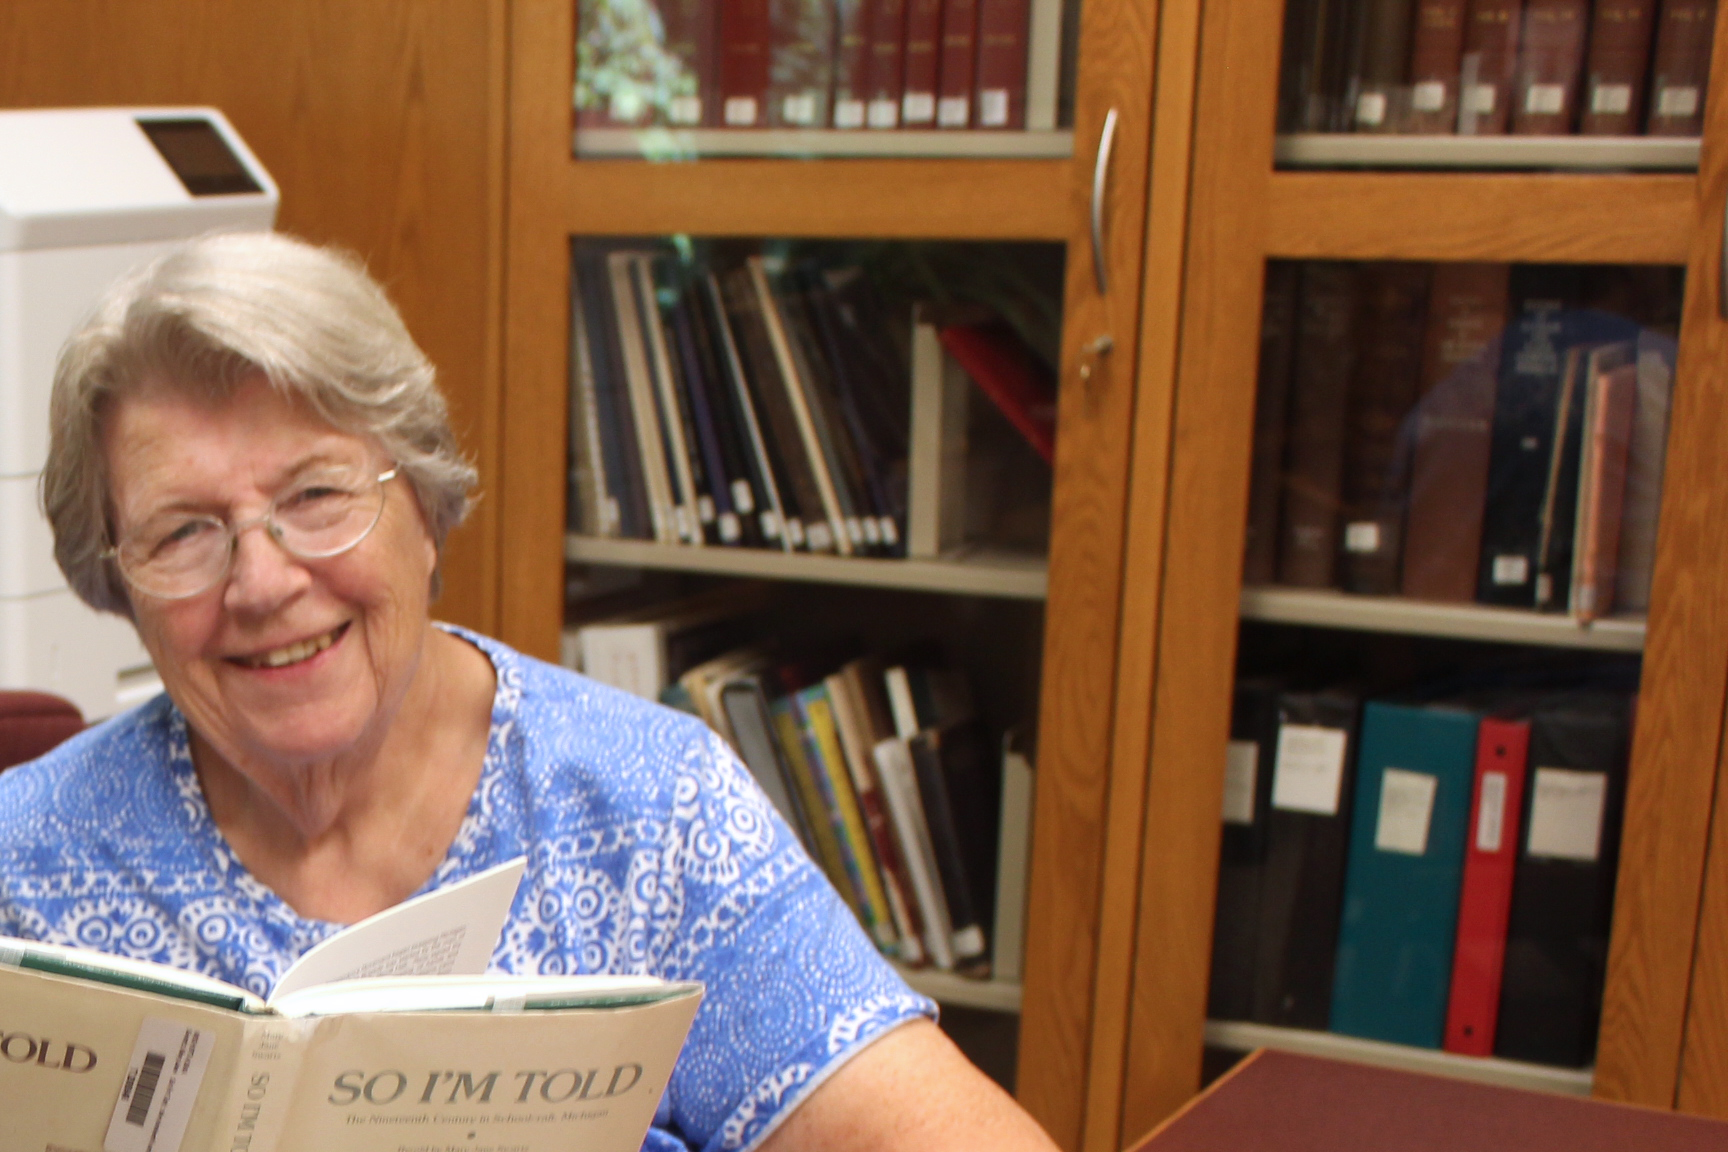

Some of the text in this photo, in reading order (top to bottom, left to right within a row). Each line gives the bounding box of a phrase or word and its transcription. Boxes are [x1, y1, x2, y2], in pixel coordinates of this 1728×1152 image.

[248, 1072, 270, 1100] SO
[327, 1062, 644, 1106] SO I'M TOLD
[369, 1114, 429, 1125] Nineteenth
